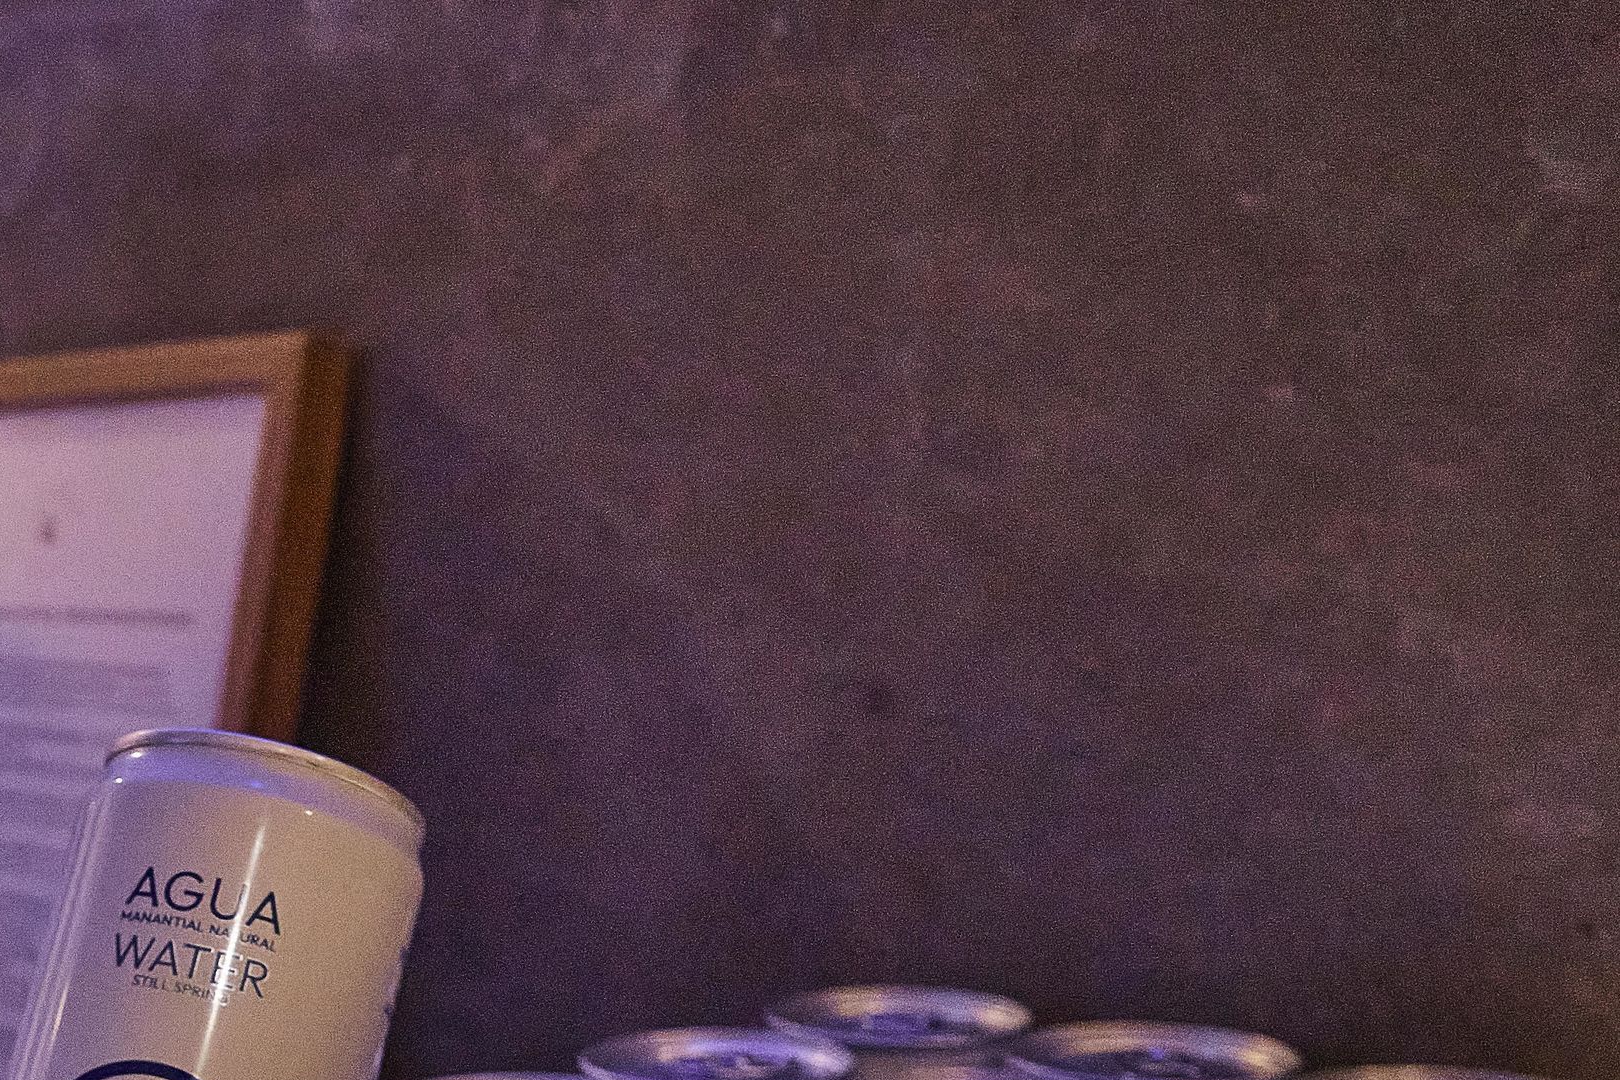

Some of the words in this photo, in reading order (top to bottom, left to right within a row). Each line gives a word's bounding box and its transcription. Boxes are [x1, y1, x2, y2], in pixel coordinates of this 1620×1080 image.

[125, 866, 280, 936] AGUA
[121, 908, 204, 934] MANANTIAL
[209, 924, 276, 953] NAURAL
[115, 932, 268, 998] WATER
[132, 973, 166, 992] STILL
